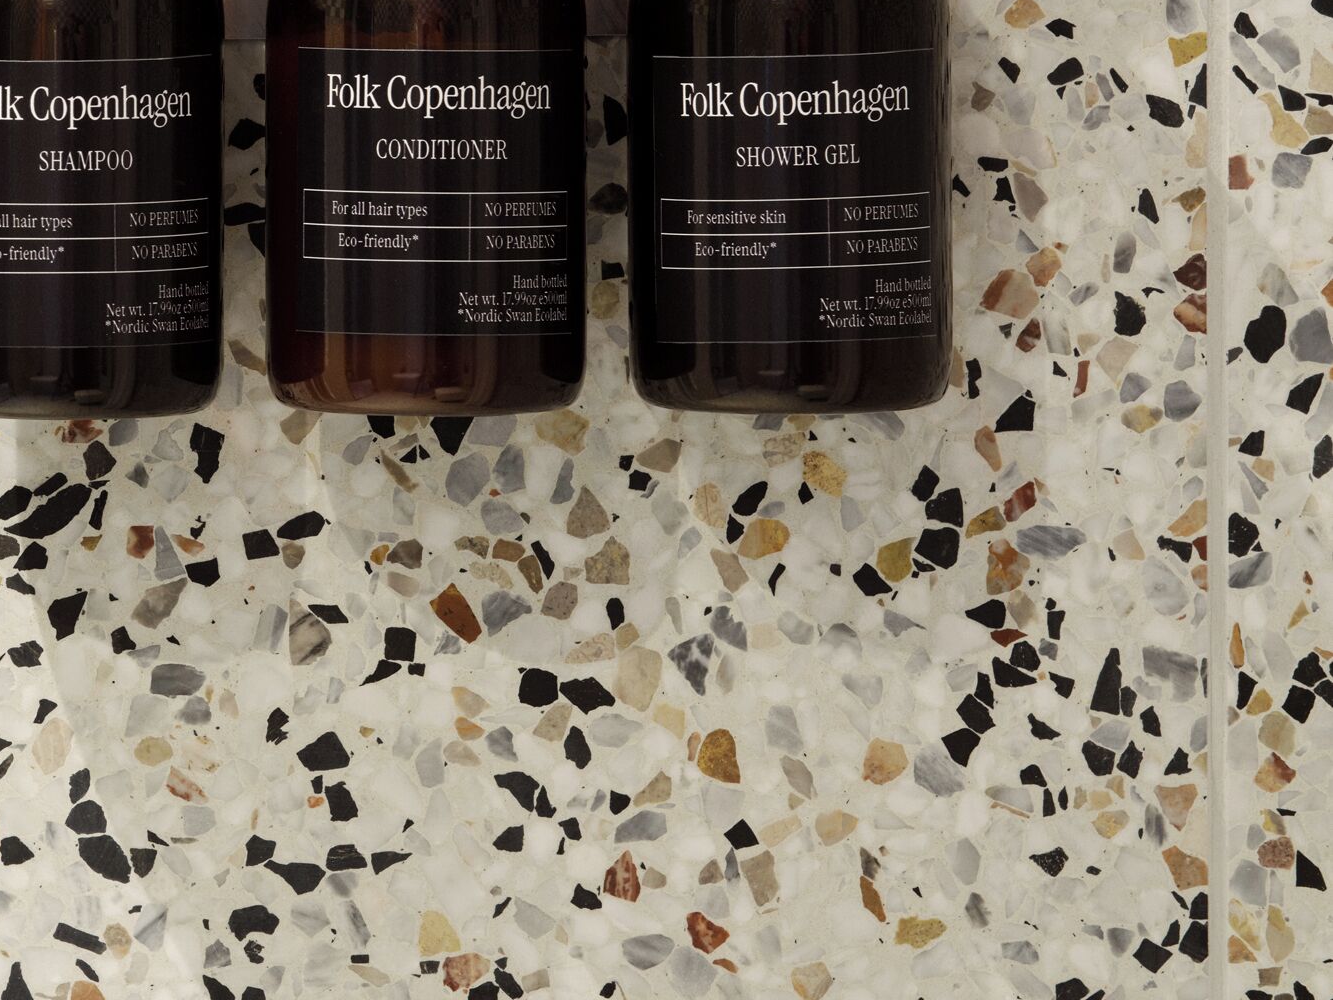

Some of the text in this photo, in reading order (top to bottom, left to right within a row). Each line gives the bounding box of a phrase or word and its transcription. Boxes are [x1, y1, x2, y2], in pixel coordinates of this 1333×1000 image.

[326, 73, 551, 119] Folk Copenhagen
[680, 80, 910, 126] Folk Copenhagen
[30, 85, 192, 130] Copenhagen
[376, 138, 508, 160] CONDITIONER
[736, 143, 860, 168] SHOWER GEL
[38, 149, 134, 172] SHAMPOO
[130, 208, 199, 228] NO PERFUMES
[332, 200, 428, 220] For all hair types
[484, 201, 557, 217] NO PERFUMES
[687, 210, 786, 225] For sensitive skin
[844, 203, 920, 222] NO PERFUMES
[12, 214, 39, 228] hair
[40, 214, 73, 232] types
[131, 242, 199, 260] NO PARABENS
[486, 234, 555, 250] NO PARABENS
[846, 236, 918, 255] NO PARABENS
[512, 274, 568, 289] Hand bottled
[875, 275, 932, 293] Hand bottled
[158, 284, 184, 299] Hand
[459, 292, 479, 306] Net
[481, 294, 500, 306] wt.
[106, 303, 126, 318] Net
[128, 304, 146, 317] wt.
[505, 308, 533, 322] Swan
[534, 306, 568, 322] Ecolabel
[820, 298, 841, 312] Net
[843, 299, 862, 312] wt.
[152, 318, 178, 333] Swan
[868, 312, 896, 327] Swan
[898, 310, 932, 326] Ecolabel
